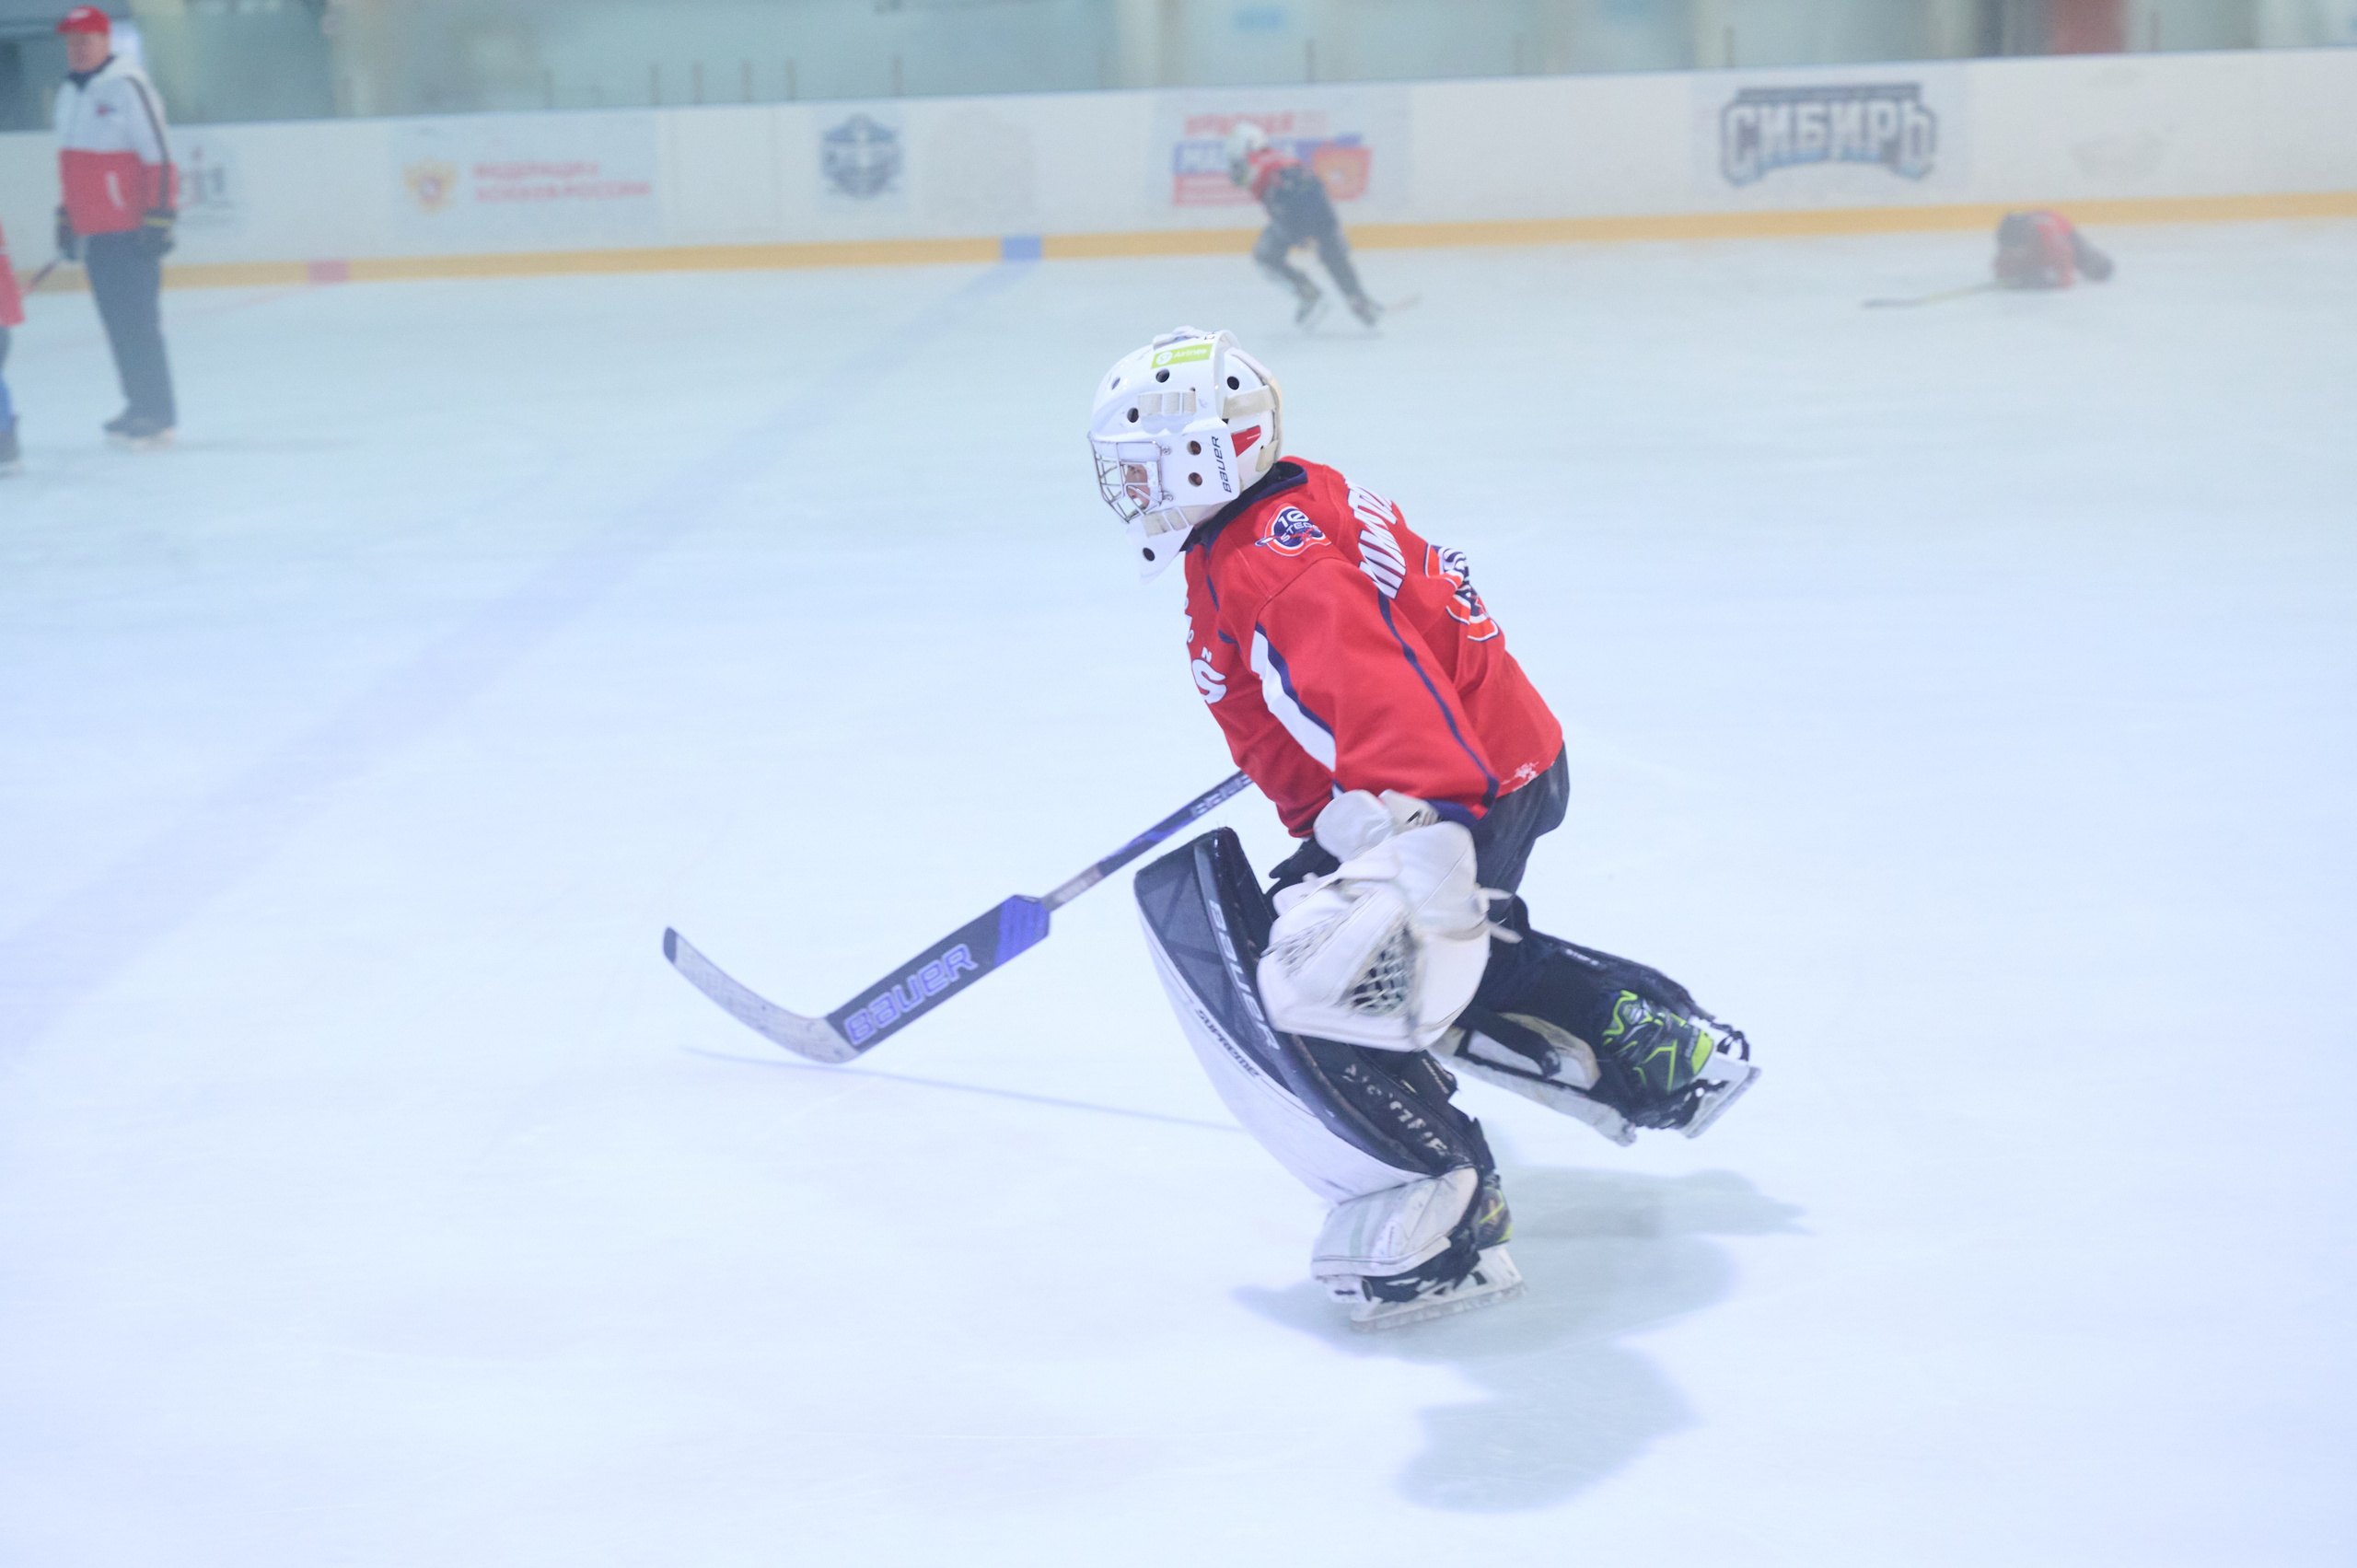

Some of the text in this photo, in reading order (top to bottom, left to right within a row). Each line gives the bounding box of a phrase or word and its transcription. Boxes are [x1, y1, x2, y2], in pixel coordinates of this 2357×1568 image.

[1720, 98, 1939, 184] СИБИРЬ
[1211, 436, 1233, 494] BAUER
[843, 943, 980, 1047] BAUER
[1208, 899, 1281, 1051] BAUER
[1195, 1007, 1265, 1079] SUPREME
